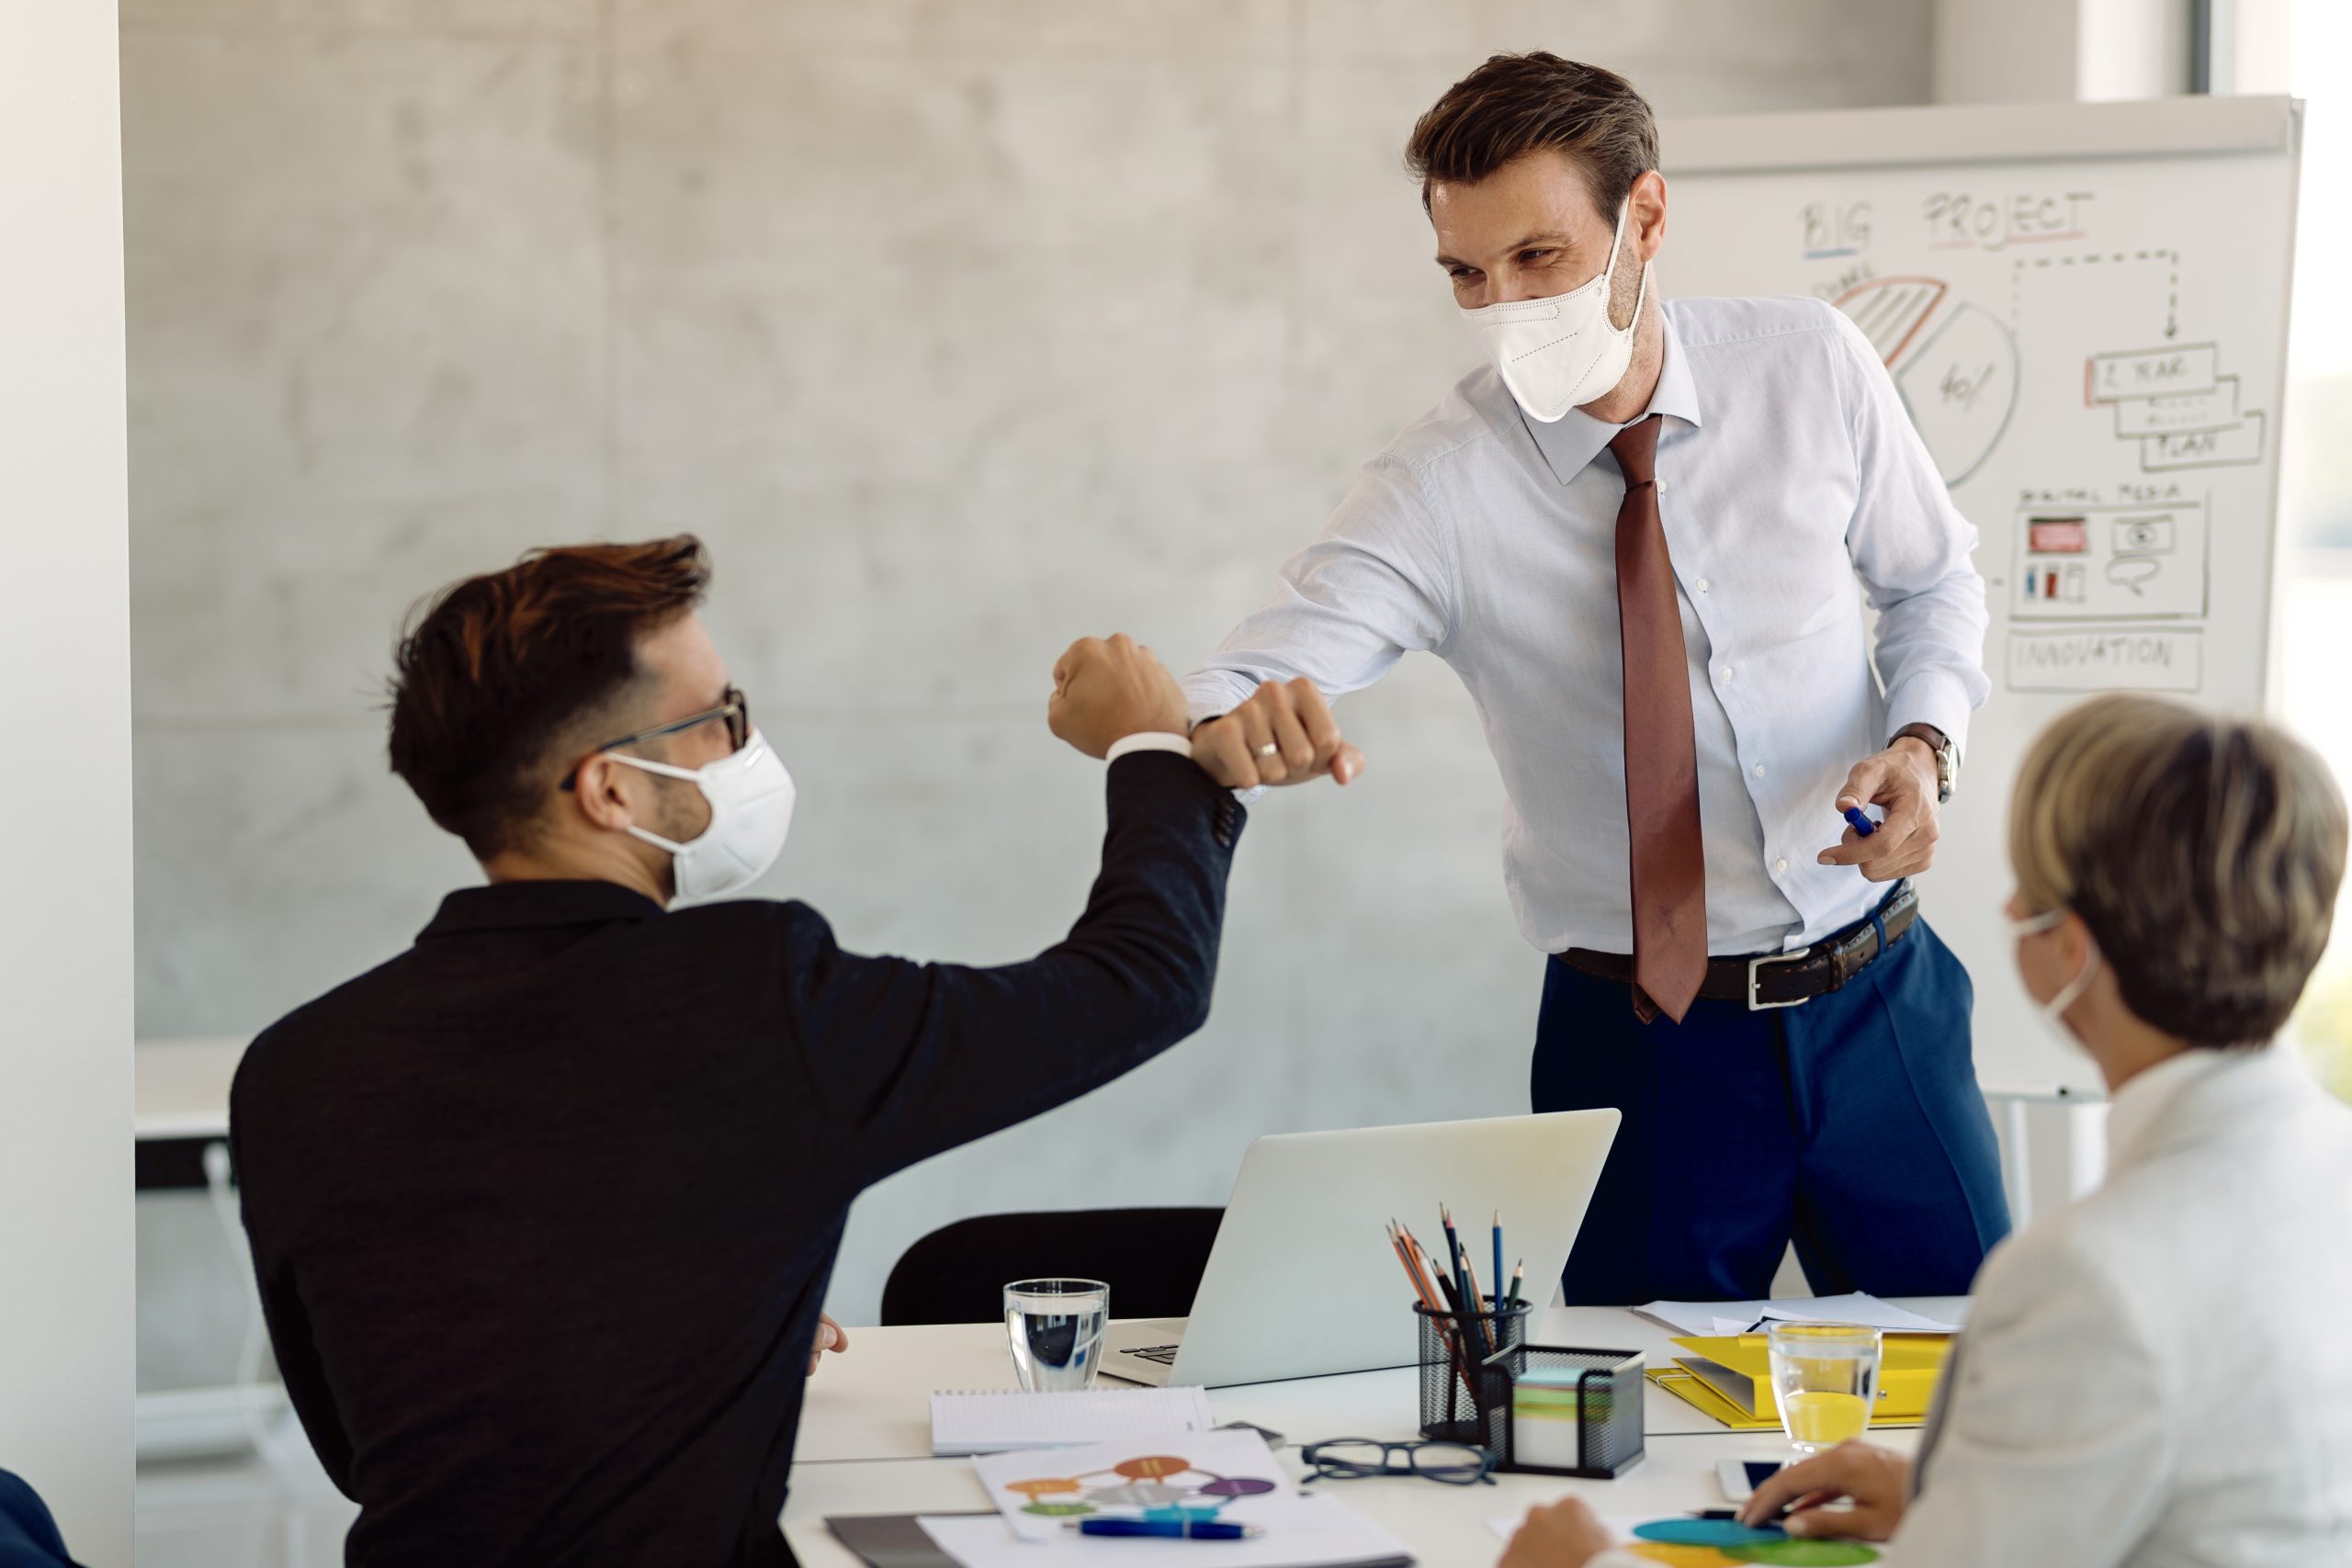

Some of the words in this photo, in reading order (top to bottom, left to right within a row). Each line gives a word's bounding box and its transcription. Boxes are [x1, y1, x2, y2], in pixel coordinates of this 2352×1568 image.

[1799, 199, 1873, 250] BIG
[1924, 191, 2095, 252] PROJECT
[2132, 355, 2188, 382] YEAR
[2157, 431, 2217, 458] PLAN
[2019, 489, 2102, 503] DIGITAL
[2117, 480, 2180, 501] MEDIA
[2016, 636, 2174, 669] INNOVATION
